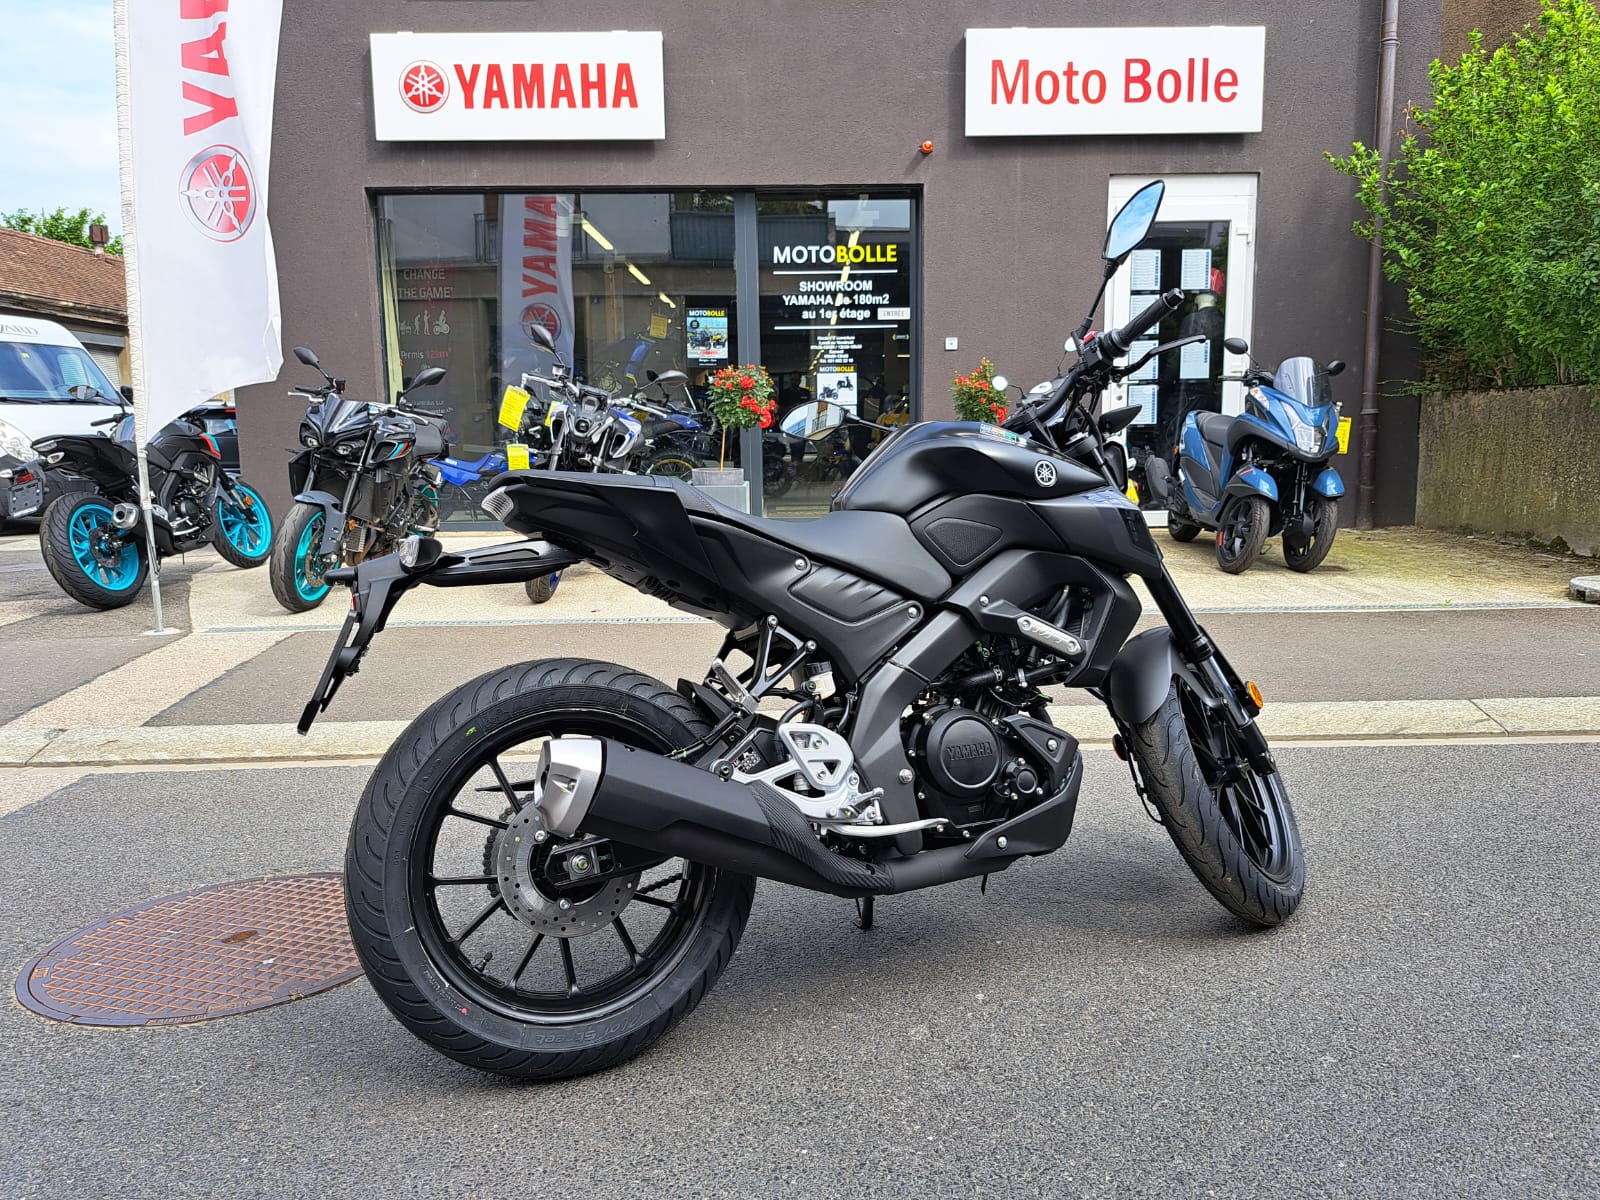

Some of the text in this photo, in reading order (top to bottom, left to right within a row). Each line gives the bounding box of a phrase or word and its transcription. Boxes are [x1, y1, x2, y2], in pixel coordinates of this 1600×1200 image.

[453, 63, 639, 109] YAMAHA
[990, 57, 1239, 105] Moto Bolle
[772, 244, 898, 264] MOTOBOLLE
[799, 280, 873, 292] SHOWROOM
[782, 295, 834, 306] YAMAHA
[852, 293, 890, 305] 180m2
[801, 307, 871, 320] au 1er étage
[946, 741, 993, 761] YAMAHA
